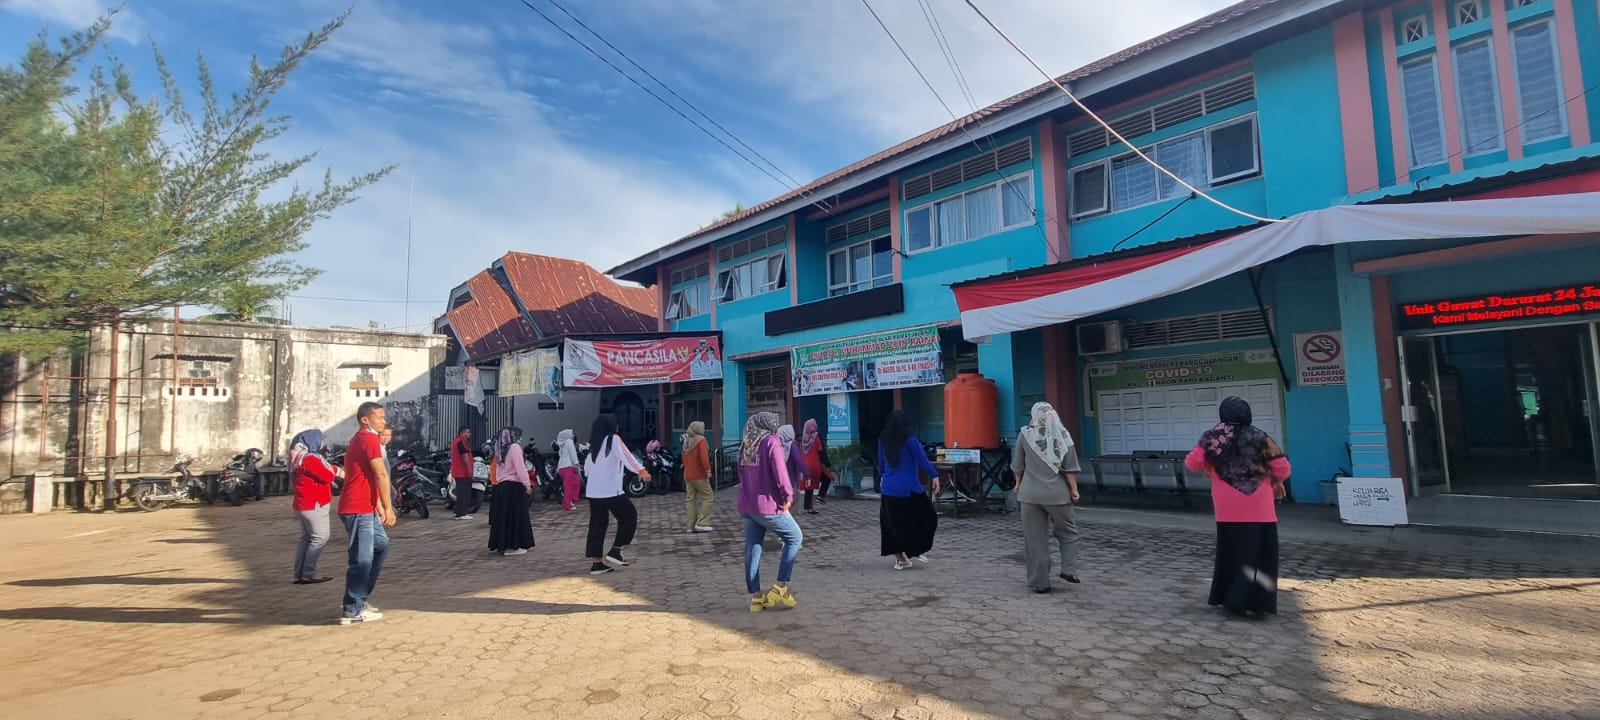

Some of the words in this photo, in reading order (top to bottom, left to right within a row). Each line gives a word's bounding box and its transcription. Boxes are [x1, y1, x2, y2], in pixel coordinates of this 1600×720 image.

[1403, 303, 1435, 316] Unit
[1437, 299, 1486, 312] Gawat
[1488, 292, 1552, 307] Darurat
[1554, 287, 1577, 301] 24
[1432, 312, 1465, 324] Kami
[1466, 307, 1523, 322] Melayani
[1525, 303, 1581, 316] Dengan
[841, 342, 885, 354] MUHAMMAD
[888, 338, 908, 349] ZEIN
[607, 349, 677, 365] PANCASILA
[1145, 366, 1213, 379] COVID-19
